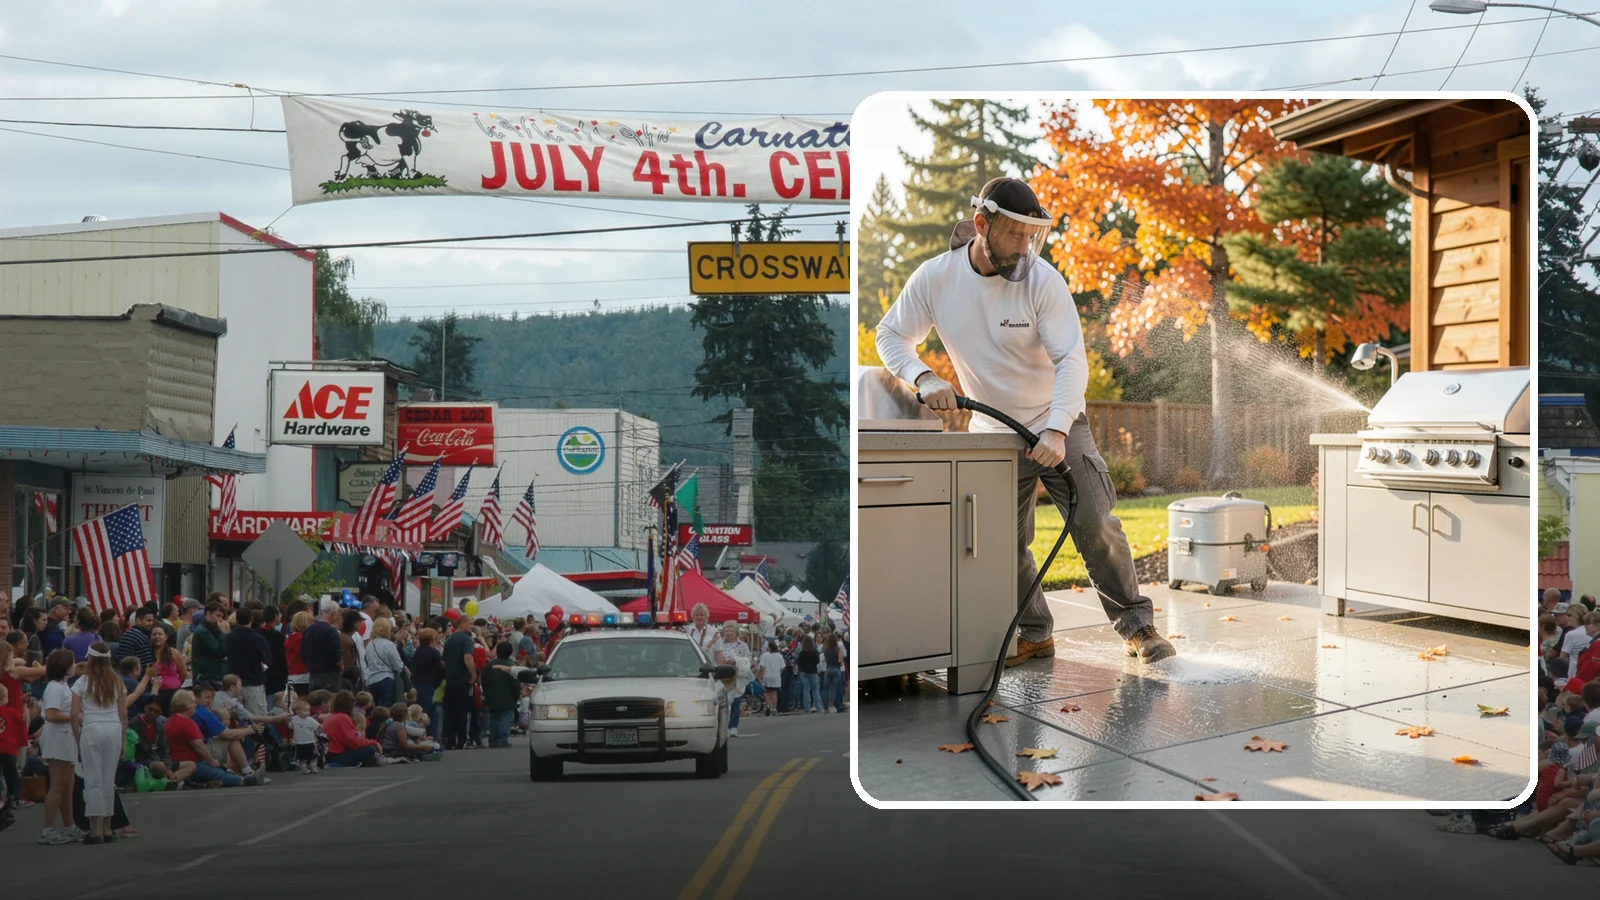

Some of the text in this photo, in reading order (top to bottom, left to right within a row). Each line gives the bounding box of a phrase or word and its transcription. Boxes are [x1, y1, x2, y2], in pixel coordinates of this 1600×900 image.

[481, 141, 605, 192] JULY
[632, 150, 746, 198] 4th.
[696, 254, 850, 280] CROSSWA
[282, 380, 373, 420] ACE
[405, 409, 485, 421] CEDAR LOG
[283, 421, 371, 436] Hardware
[416, 428, 477, 447] Coca-Cola
[353, 467, 385, 479] Simpl
[83, 484, 155, 495] St. Vincent de Paul
[688, 527, 741, 535] CRNATION
[699, 535, 730, 543] GLASS
